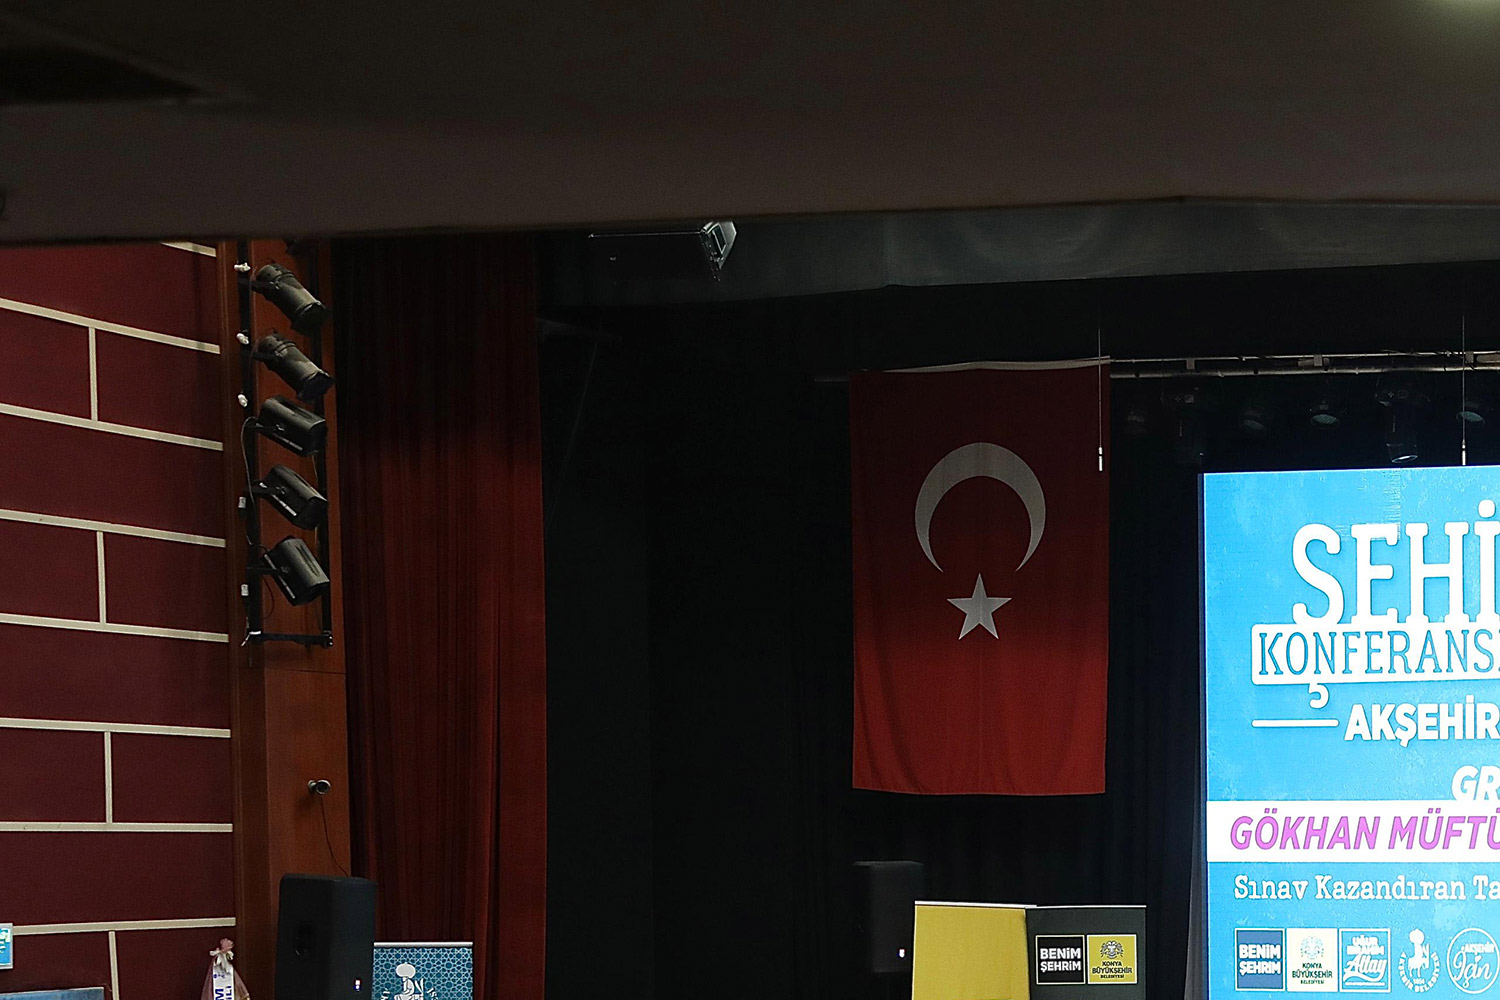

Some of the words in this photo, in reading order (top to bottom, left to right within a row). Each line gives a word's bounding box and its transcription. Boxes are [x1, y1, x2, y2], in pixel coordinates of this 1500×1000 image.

[1230, 808, 1381, 851] GÖKHAN
[1233, 874, 1308, 901] Sınav
[1314, 875, 1467, 901] Kazandıran
